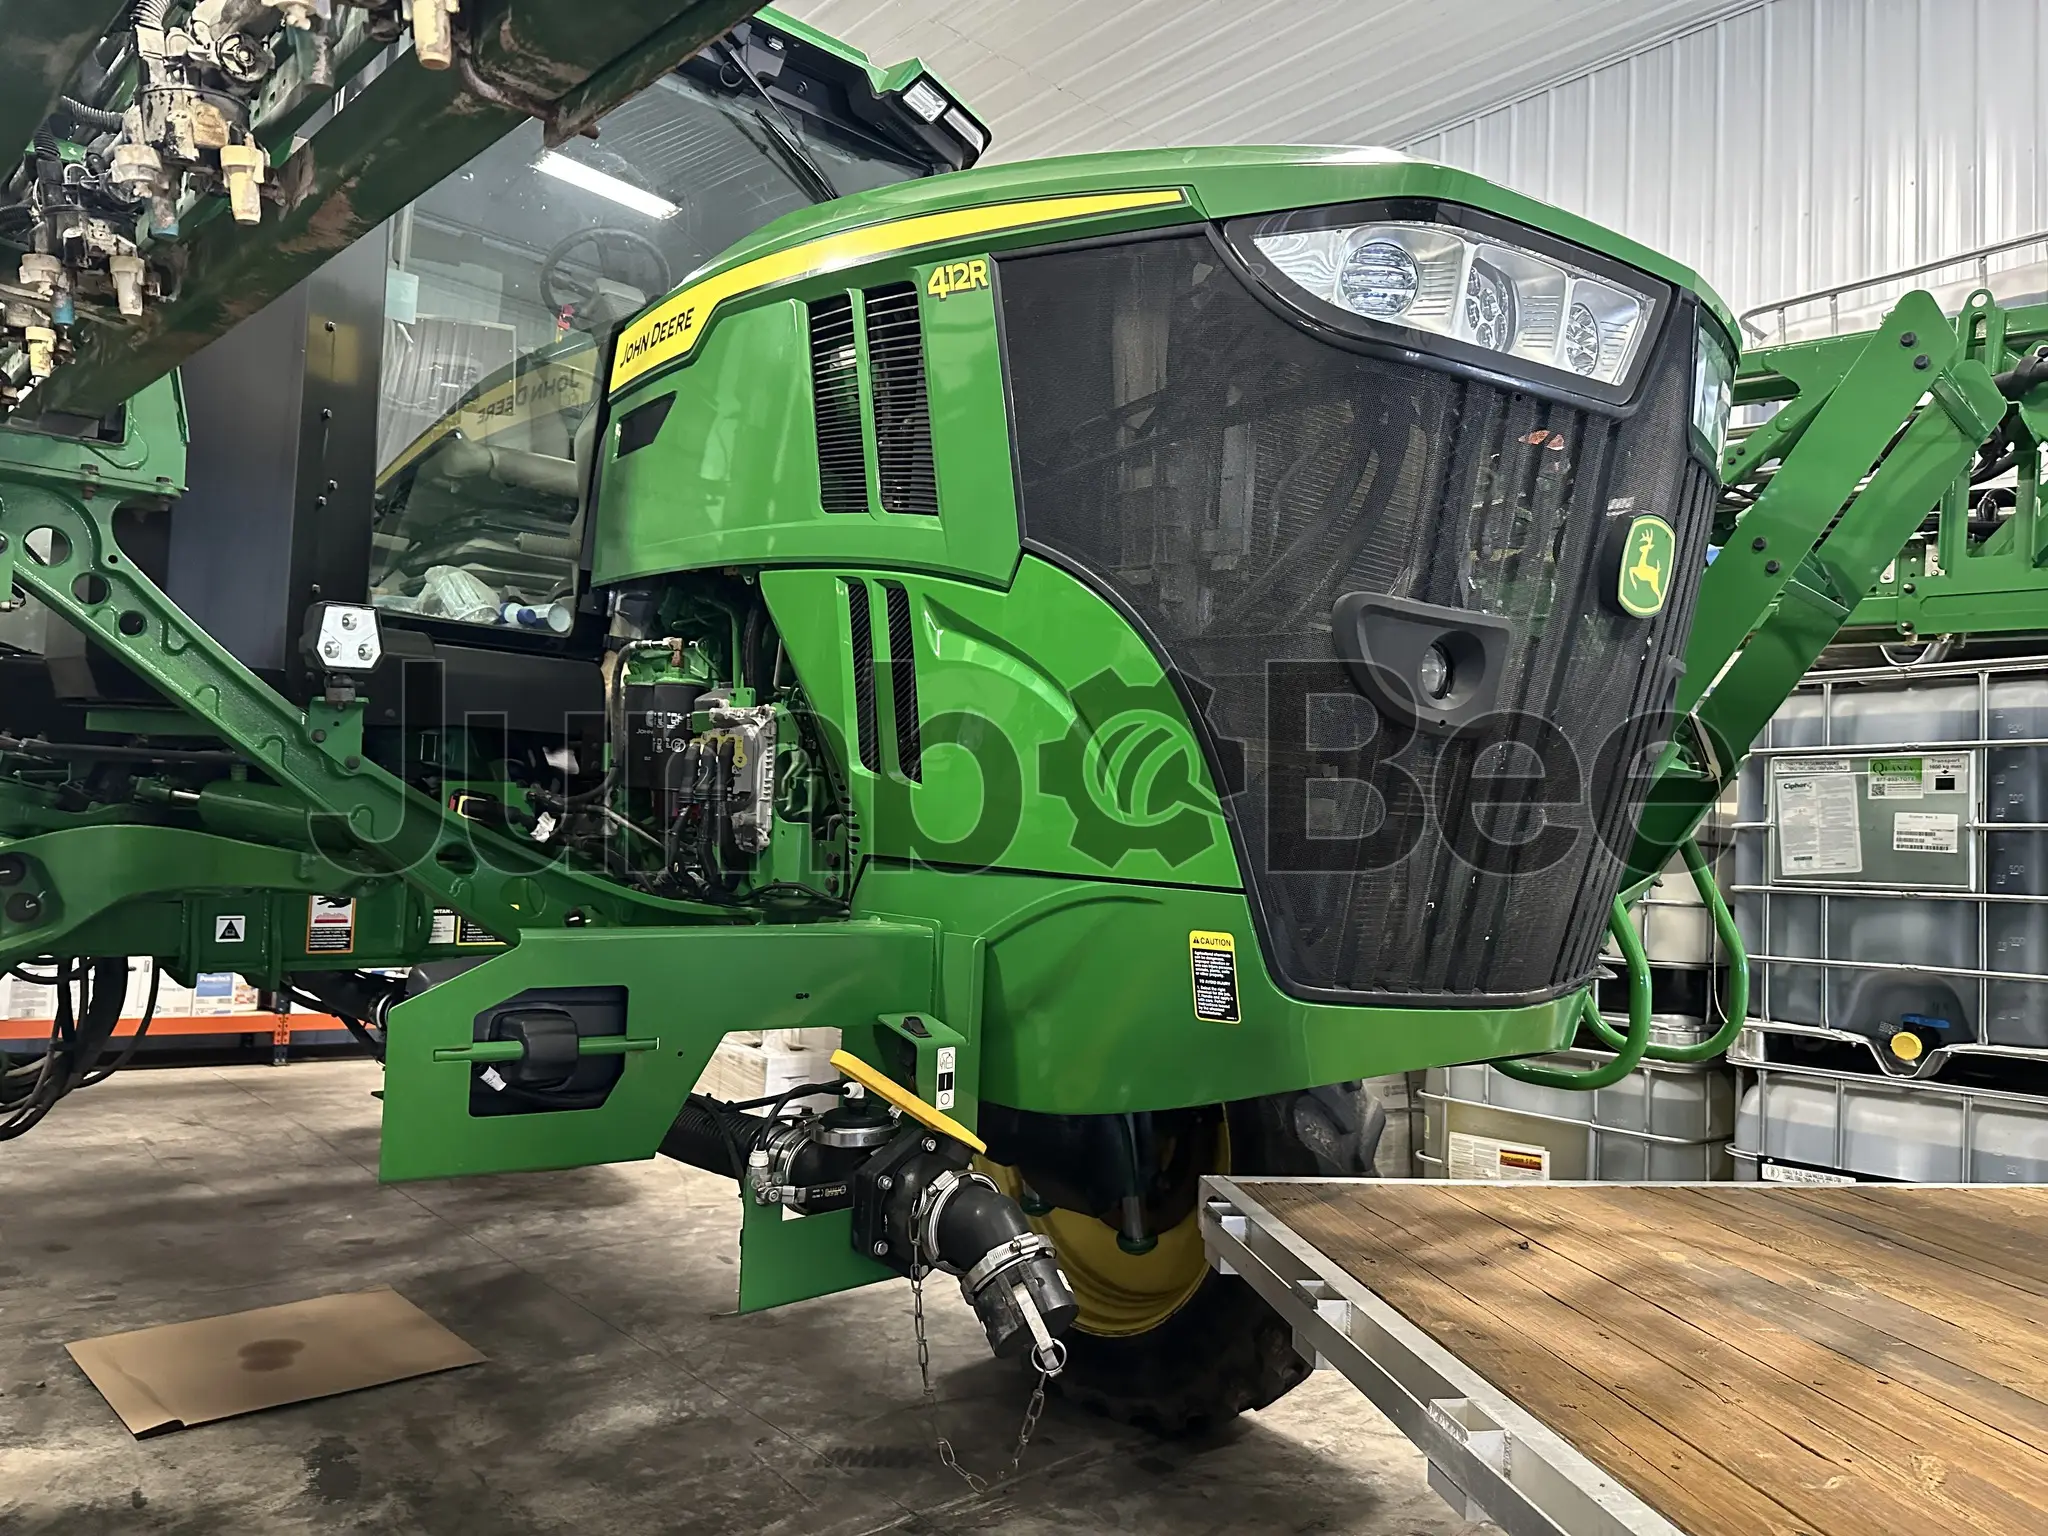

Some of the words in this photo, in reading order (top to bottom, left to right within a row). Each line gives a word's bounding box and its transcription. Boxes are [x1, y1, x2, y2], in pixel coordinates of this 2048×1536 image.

[927, 259, 989, 300] 412R
[619, 331, 651, 369] JOHN
[649, 306, 696, 349] DEERE
[1200, 937, 1231, 946] CAUTION
